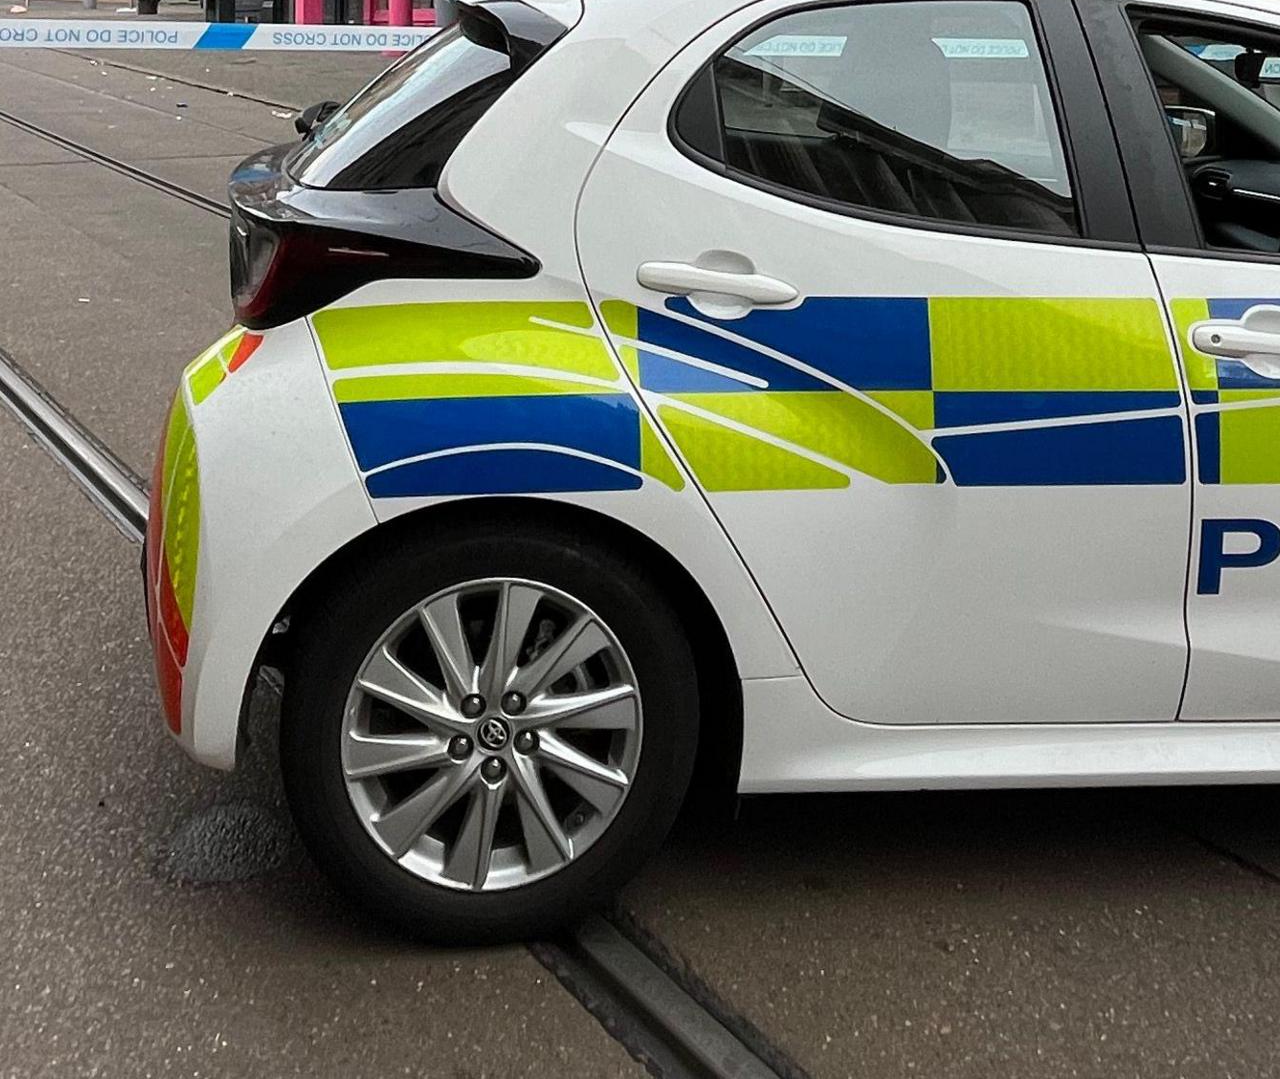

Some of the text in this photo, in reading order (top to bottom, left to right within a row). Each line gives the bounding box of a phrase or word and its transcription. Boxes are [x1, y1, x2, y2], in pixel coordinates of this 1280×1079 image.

[47, 28, 81, 43] NOT
[86, 29, 111, 43] DO
[117, 29, 178, 44] POLICE
[273, 32, 430, 46] LICE DO NOT CROSS
